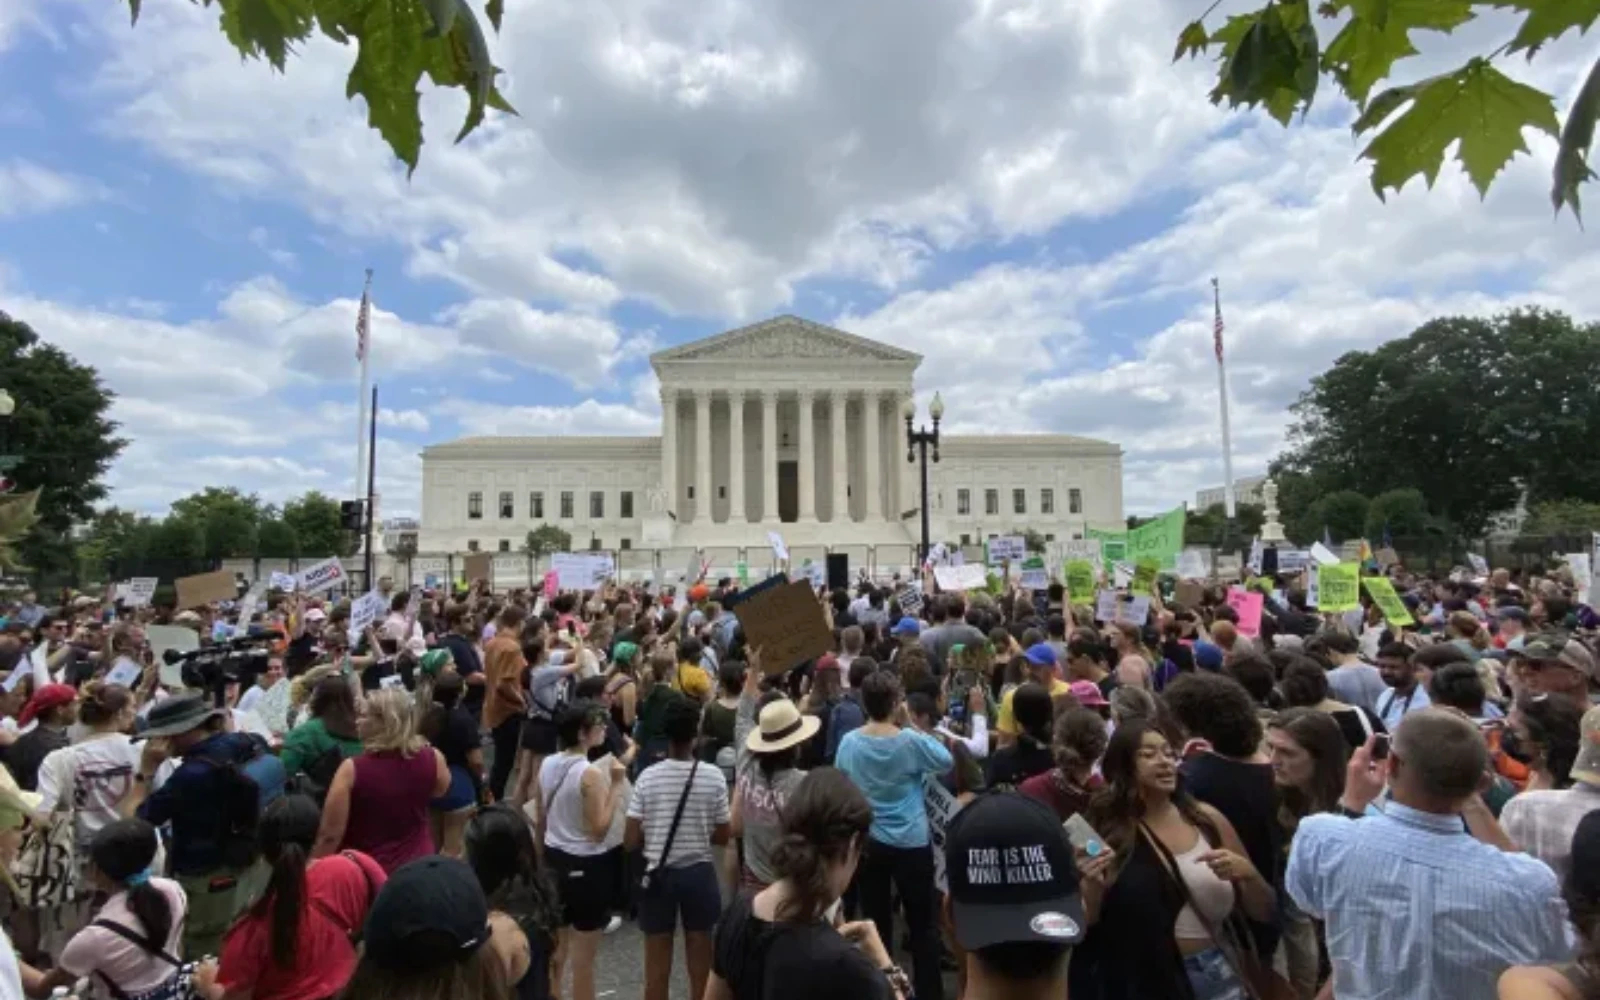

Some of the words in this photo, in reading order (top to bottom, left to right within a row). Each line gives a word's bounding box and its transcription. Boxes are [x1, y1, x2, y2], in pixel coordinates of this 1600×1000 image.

[968, 848, 998, 865] FEAR
[1003, 847, 1018, 864] IS
[1020, 844, 1047, 865] THE
[1007, 863, 1053, 883] KILLER
